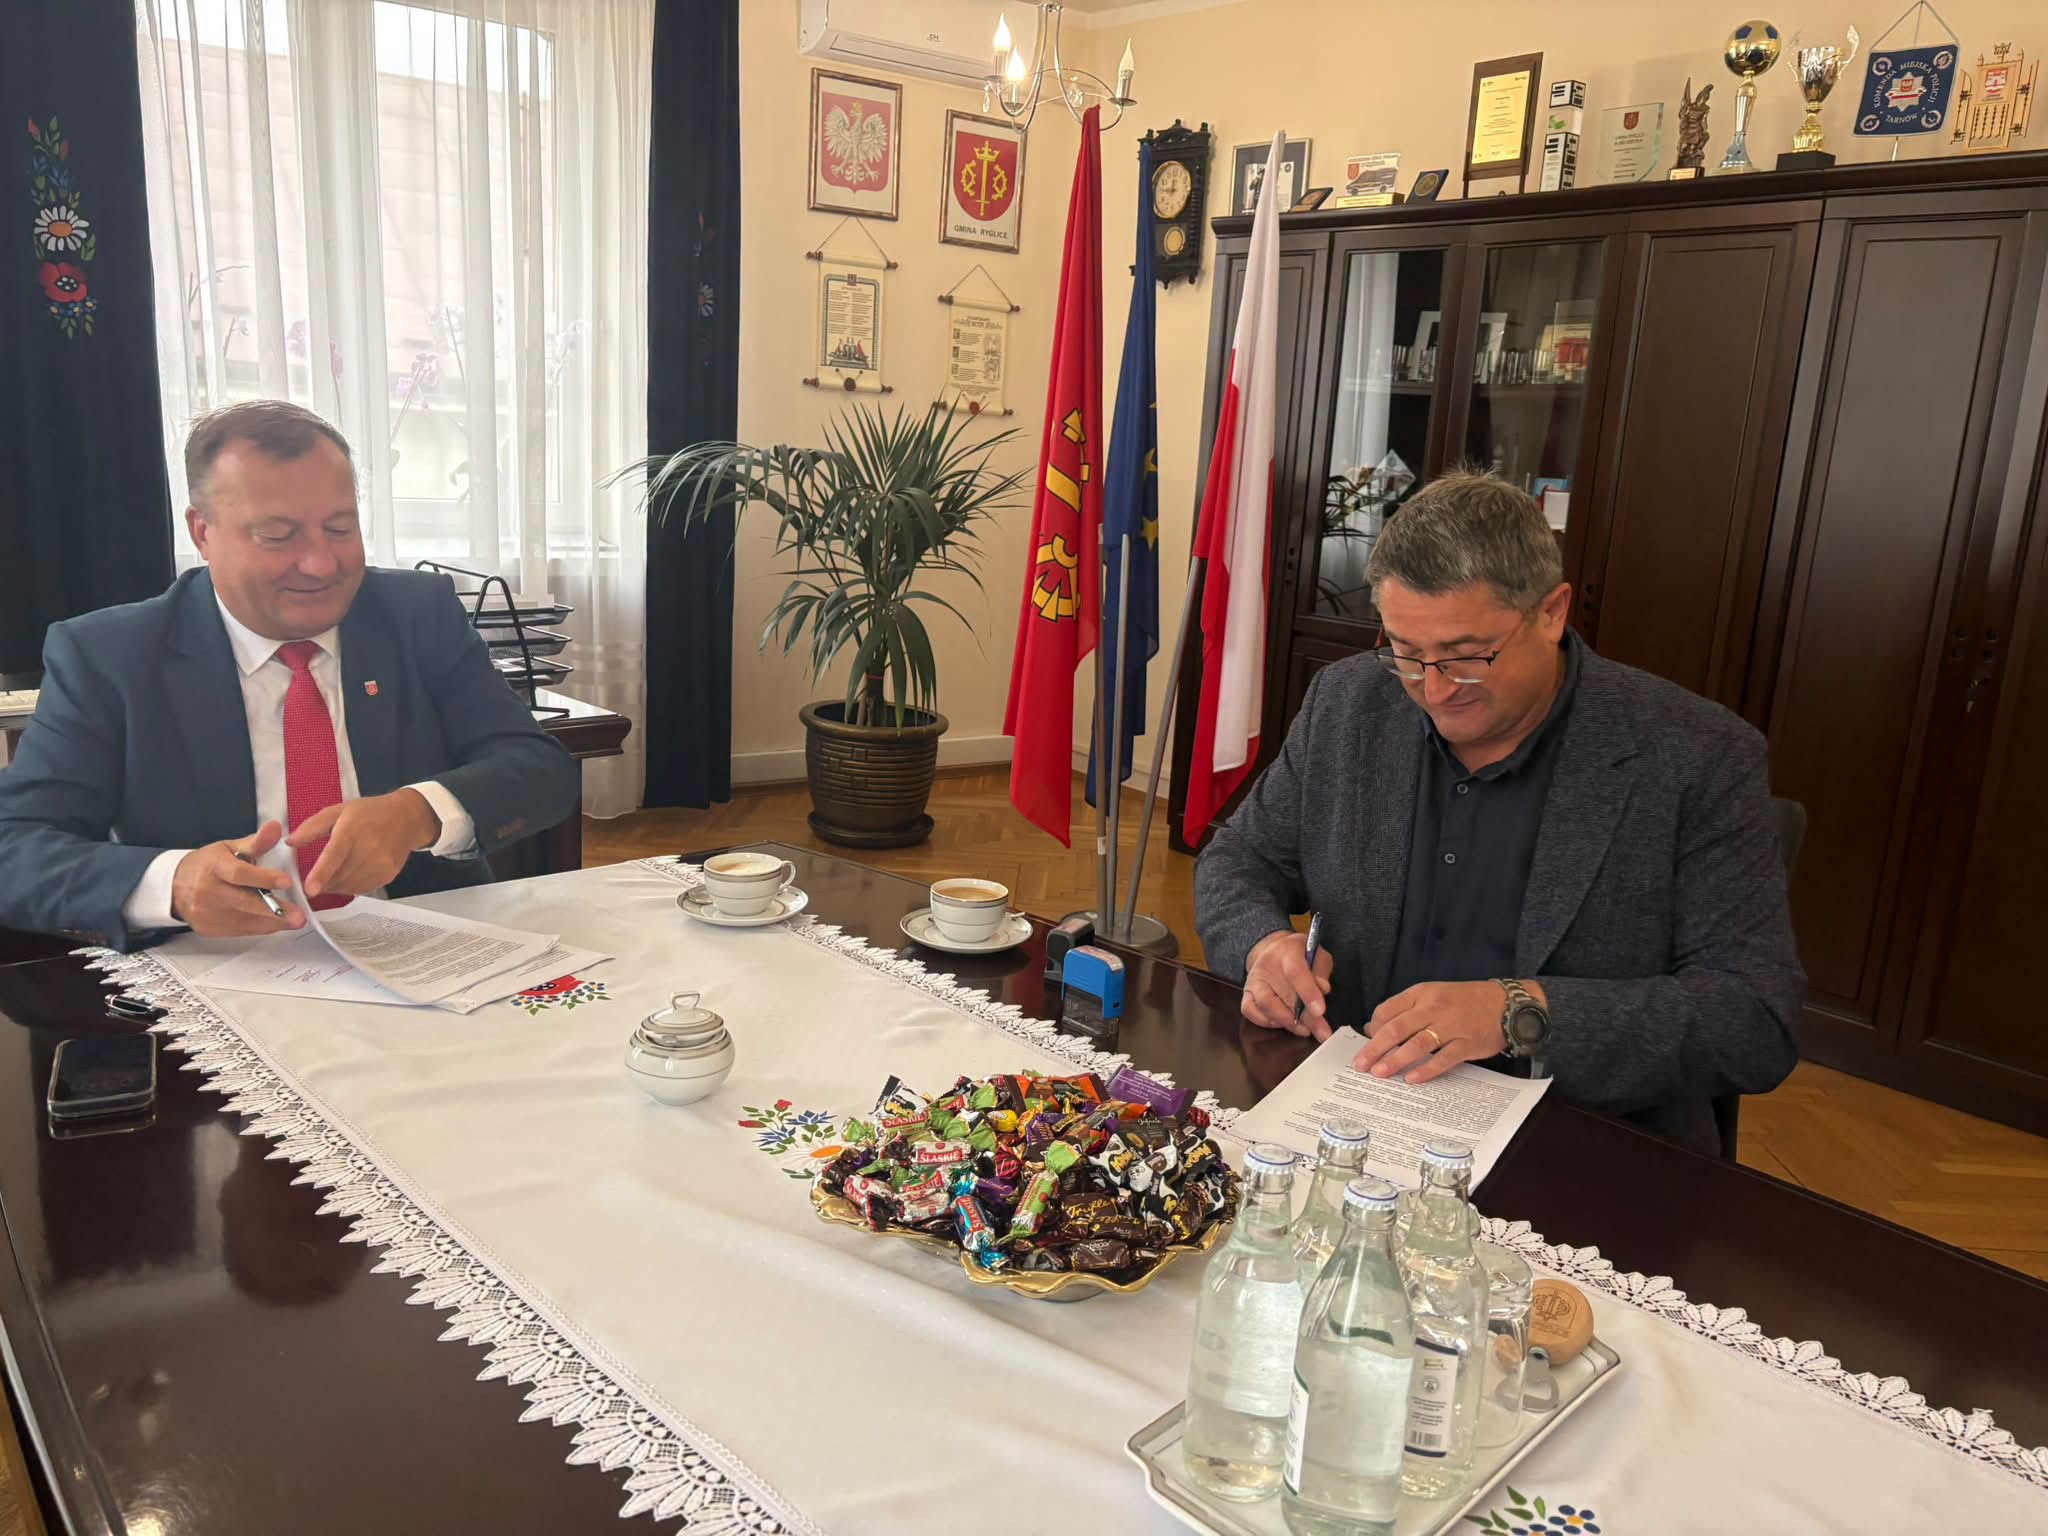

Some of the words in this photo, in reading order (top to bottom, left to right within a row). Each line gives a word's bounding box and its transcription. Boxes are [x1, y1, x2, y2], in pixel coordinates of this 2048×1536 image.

[1873, 70, 1897, 108] KOMENDA
[1900, 61, 1932, 74] MIEJSKA
[1928, 73, 1940, 103] POLICJI
[954, 224, 977, 234] GMINA
[980, 228, 1009, 239] RYGLICE
